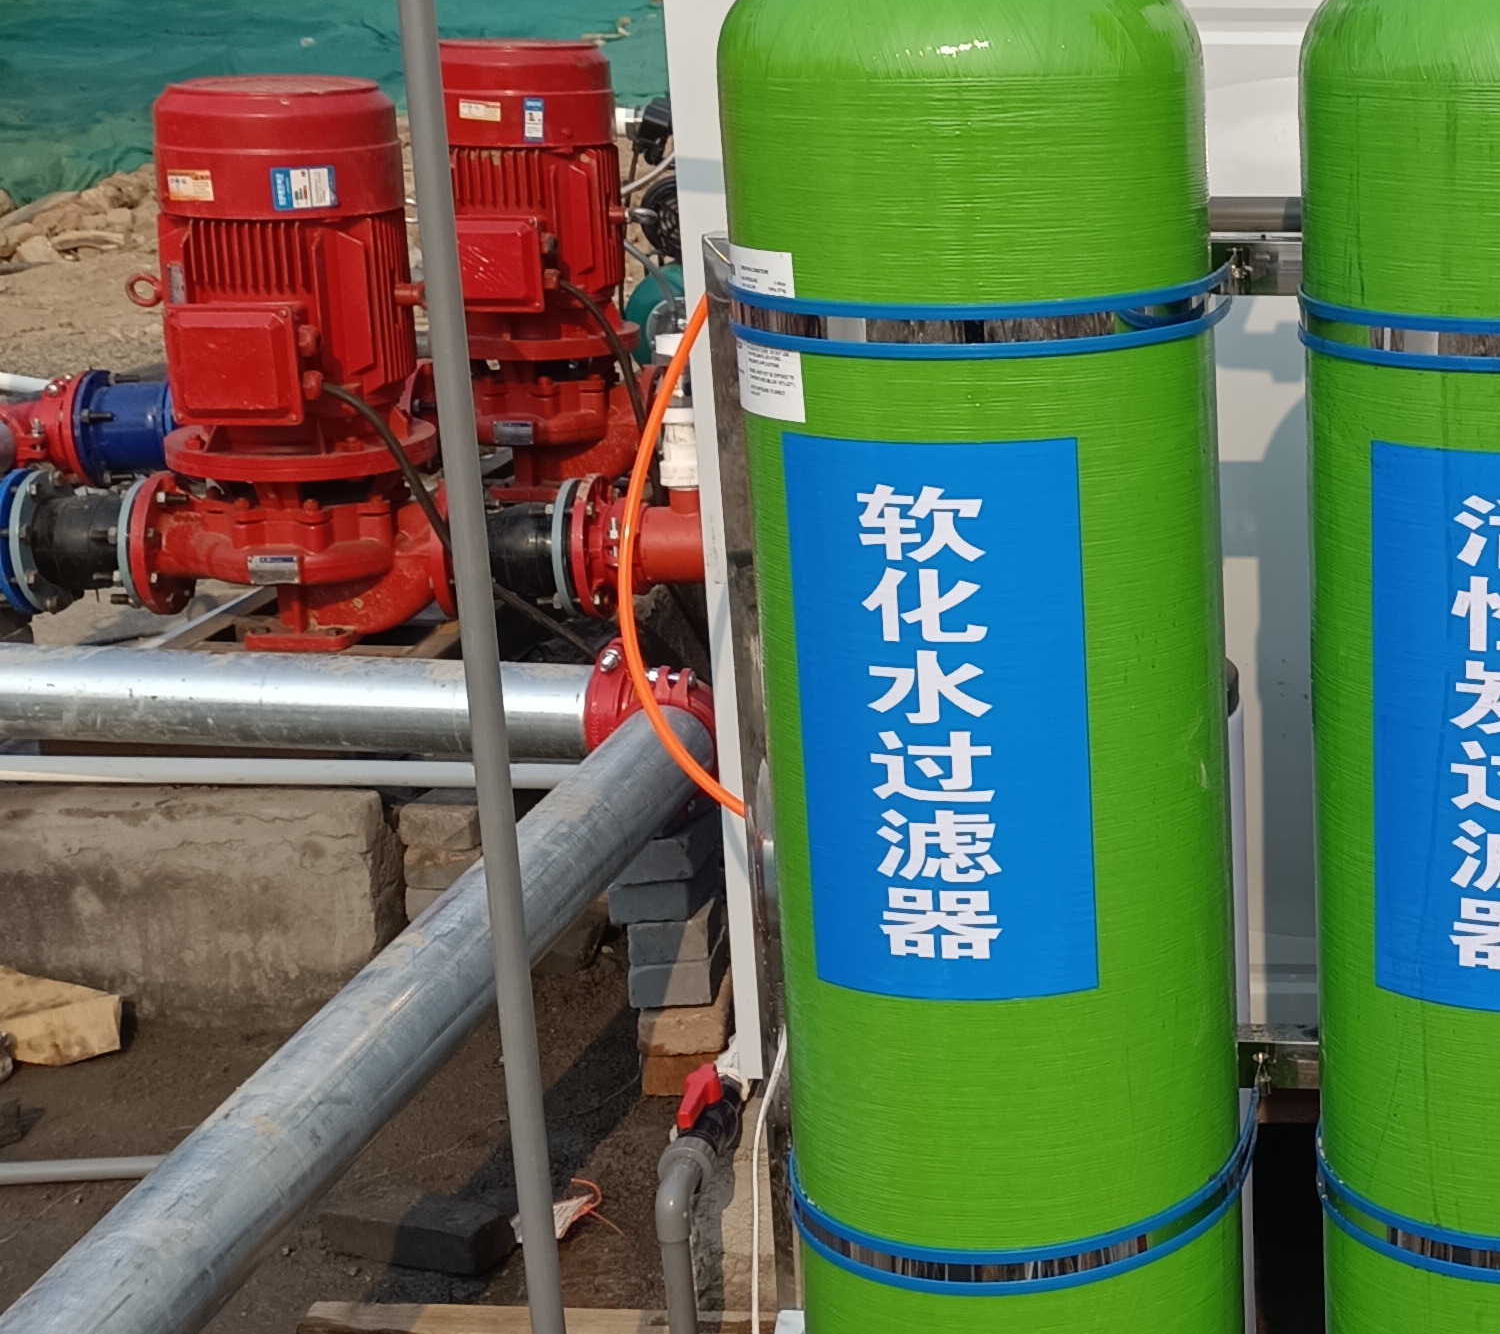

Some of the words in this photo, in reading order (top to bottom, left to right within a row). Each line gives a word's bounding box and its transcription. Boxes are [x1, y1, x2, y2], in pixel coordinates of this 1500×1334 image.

[857, 484, 1001, 960] 软化水过滤器
